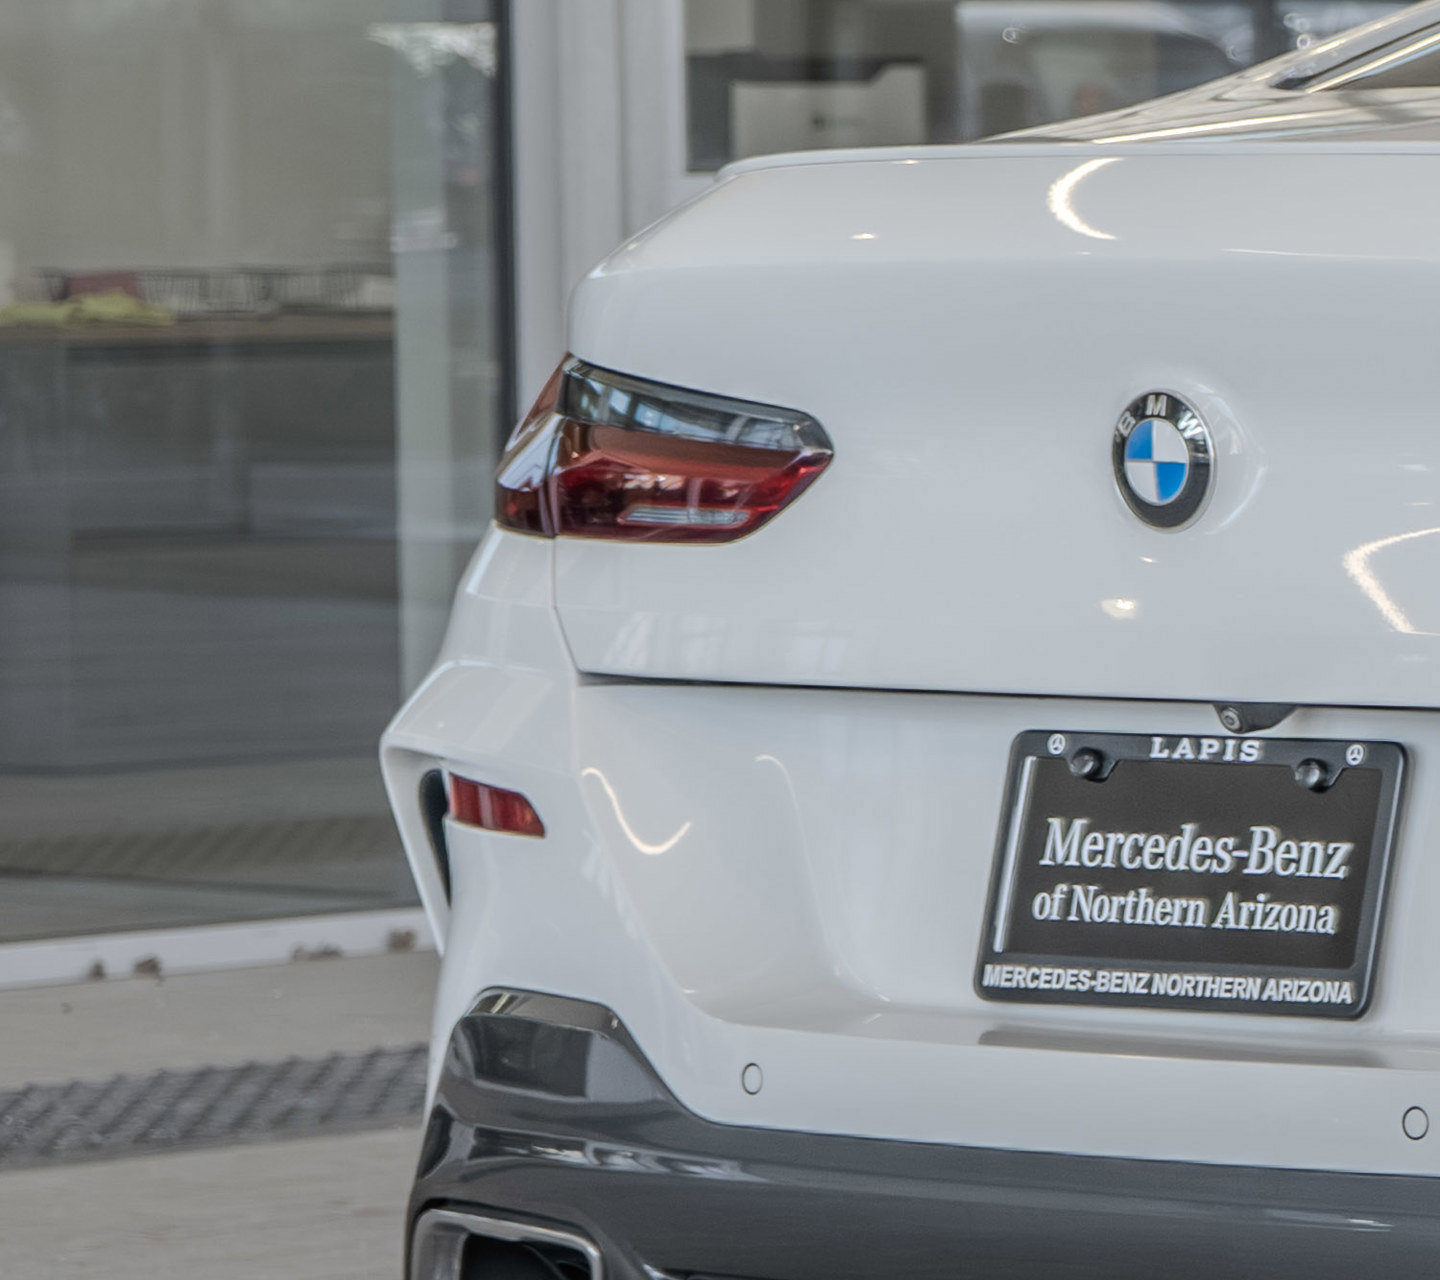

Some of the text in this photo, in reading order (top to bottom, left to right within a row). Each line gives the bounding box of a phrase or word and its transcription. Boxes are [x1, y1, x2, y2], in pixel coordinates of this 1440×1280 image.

[1117, 394, 1204, 440] BMW
[1150, 736, 1262, 762] LAPIS
[1039, 817, 1354, 880] Mercedes-Benz
[1032, 884, 1338, 936] of Northern Arizona
[982, 964, 1353, 1005] MERCEDES-BENZ NORTHERN ARIZONA
